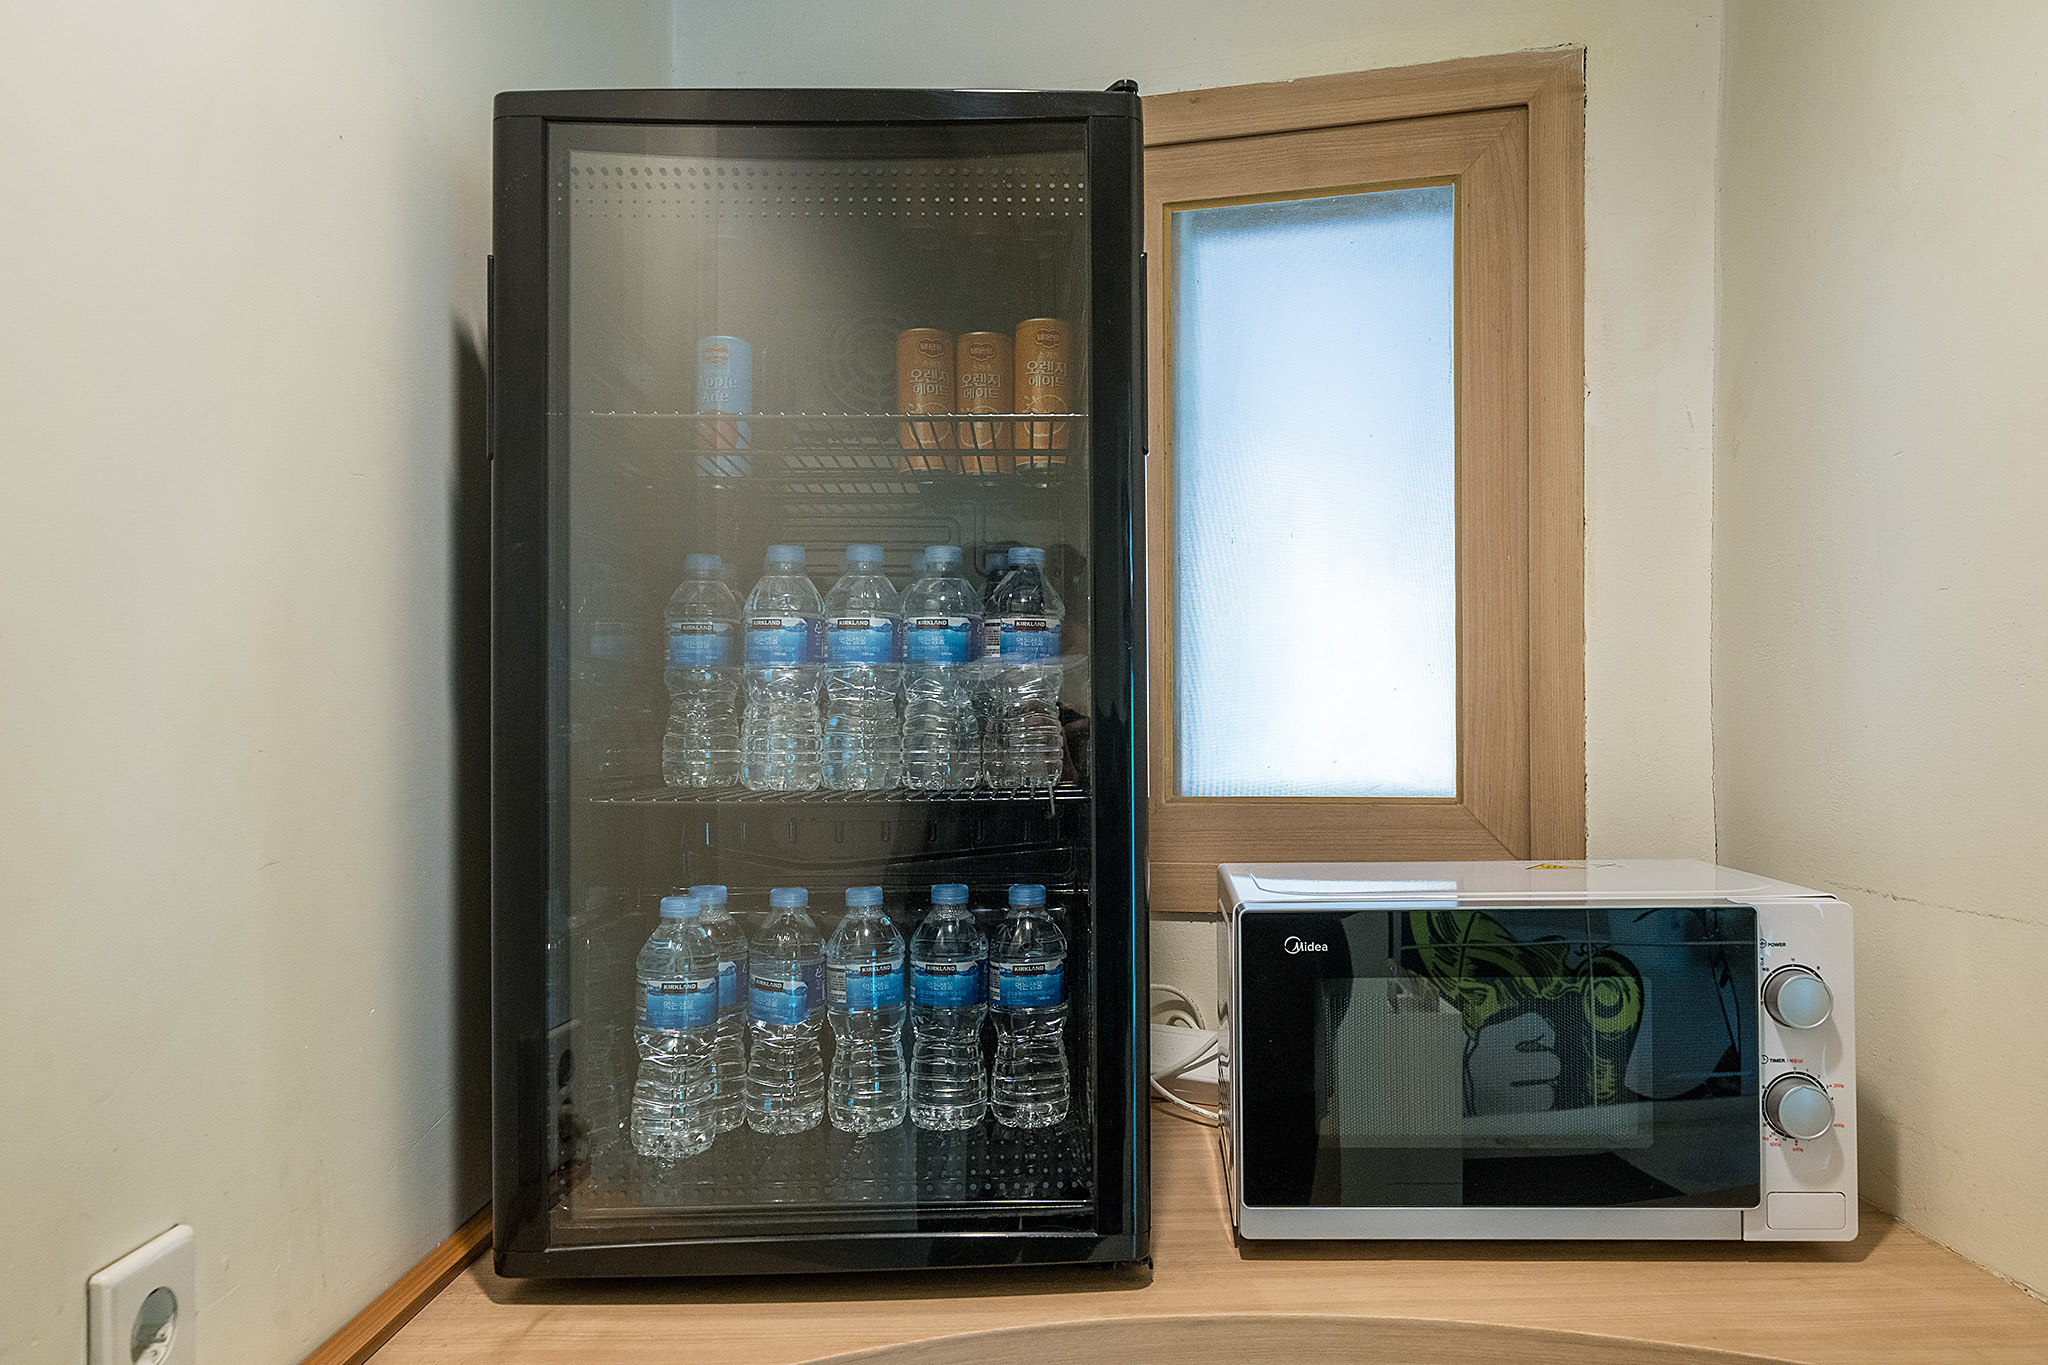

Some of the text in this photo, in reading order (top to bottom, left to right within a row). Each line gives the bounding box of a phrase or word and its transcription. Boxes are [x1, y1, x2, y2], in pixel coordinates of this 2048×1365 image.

[1026, 360, 1067, 377] 오렌지
[910, 369, 949, 383] 오렌지
[961, 373, 1001, 388] 오렌지
[1028, 376, 1066, 388] 에이드
[702, 390, 729, 402] Ade
[913, 384, 949, 396] 에이드
[963, 388, 1000, 400] 에이드
[1284, 936, 1328, 954] Midea
[861, 965, 891, 973] KIRKLAND
[755, 978, 783, 989] KIRKLAND
